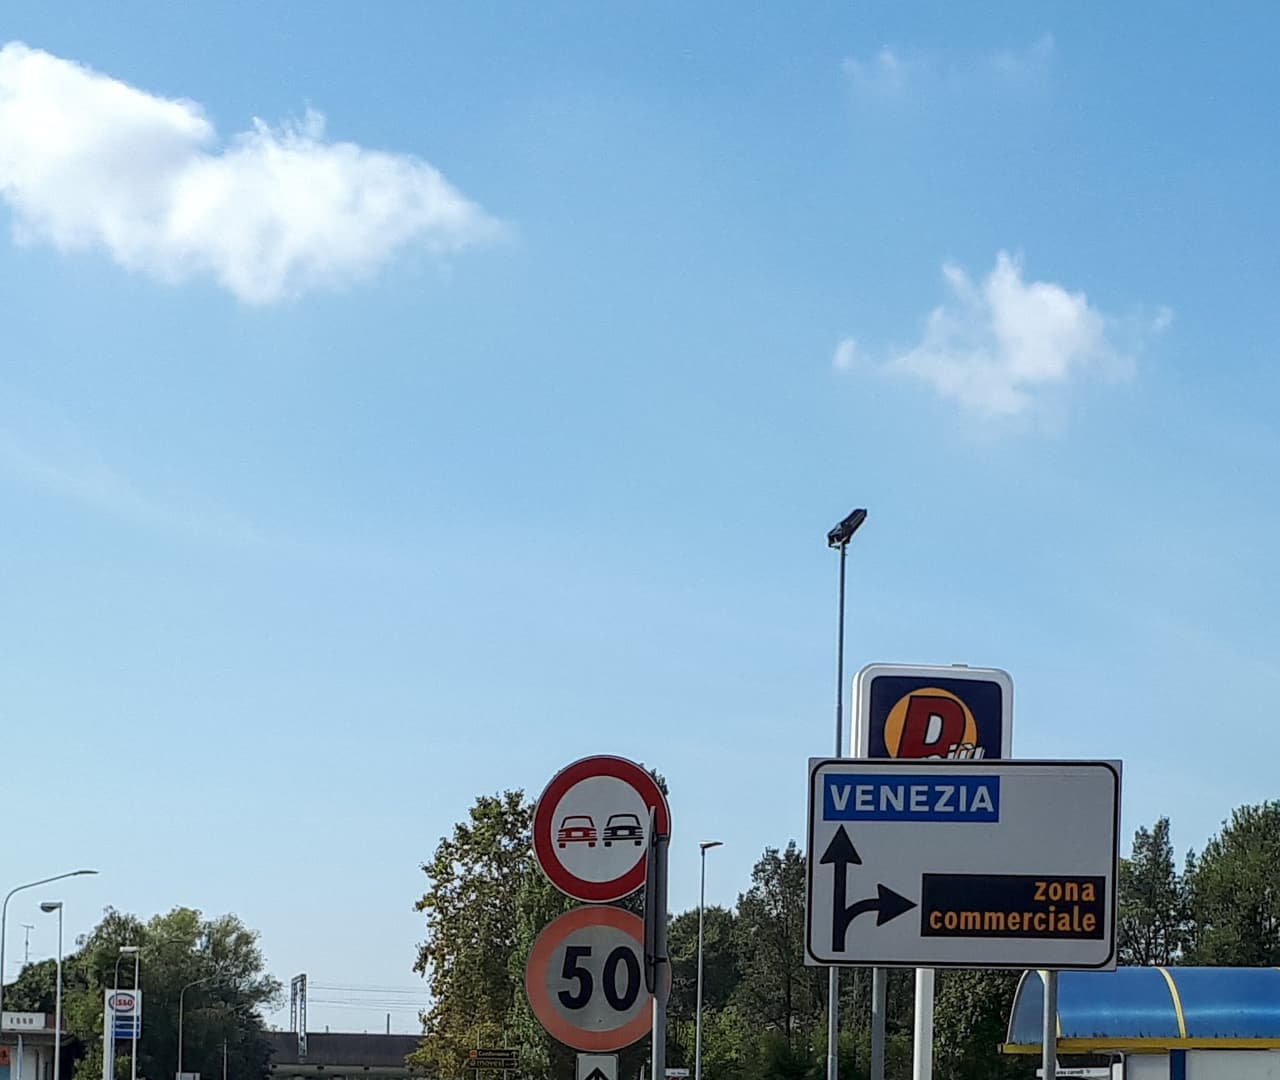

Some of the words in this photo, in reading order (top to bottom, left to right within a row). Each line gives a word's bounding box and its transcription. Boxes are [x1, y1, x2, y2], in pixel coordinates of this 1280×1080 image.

[830, 784, 995, 813] VENEZIA
[1033, 881, 1096, 902] zona
[929, 905, 1096, 932] commerciale
[557, 946, 641, 1011] 50
